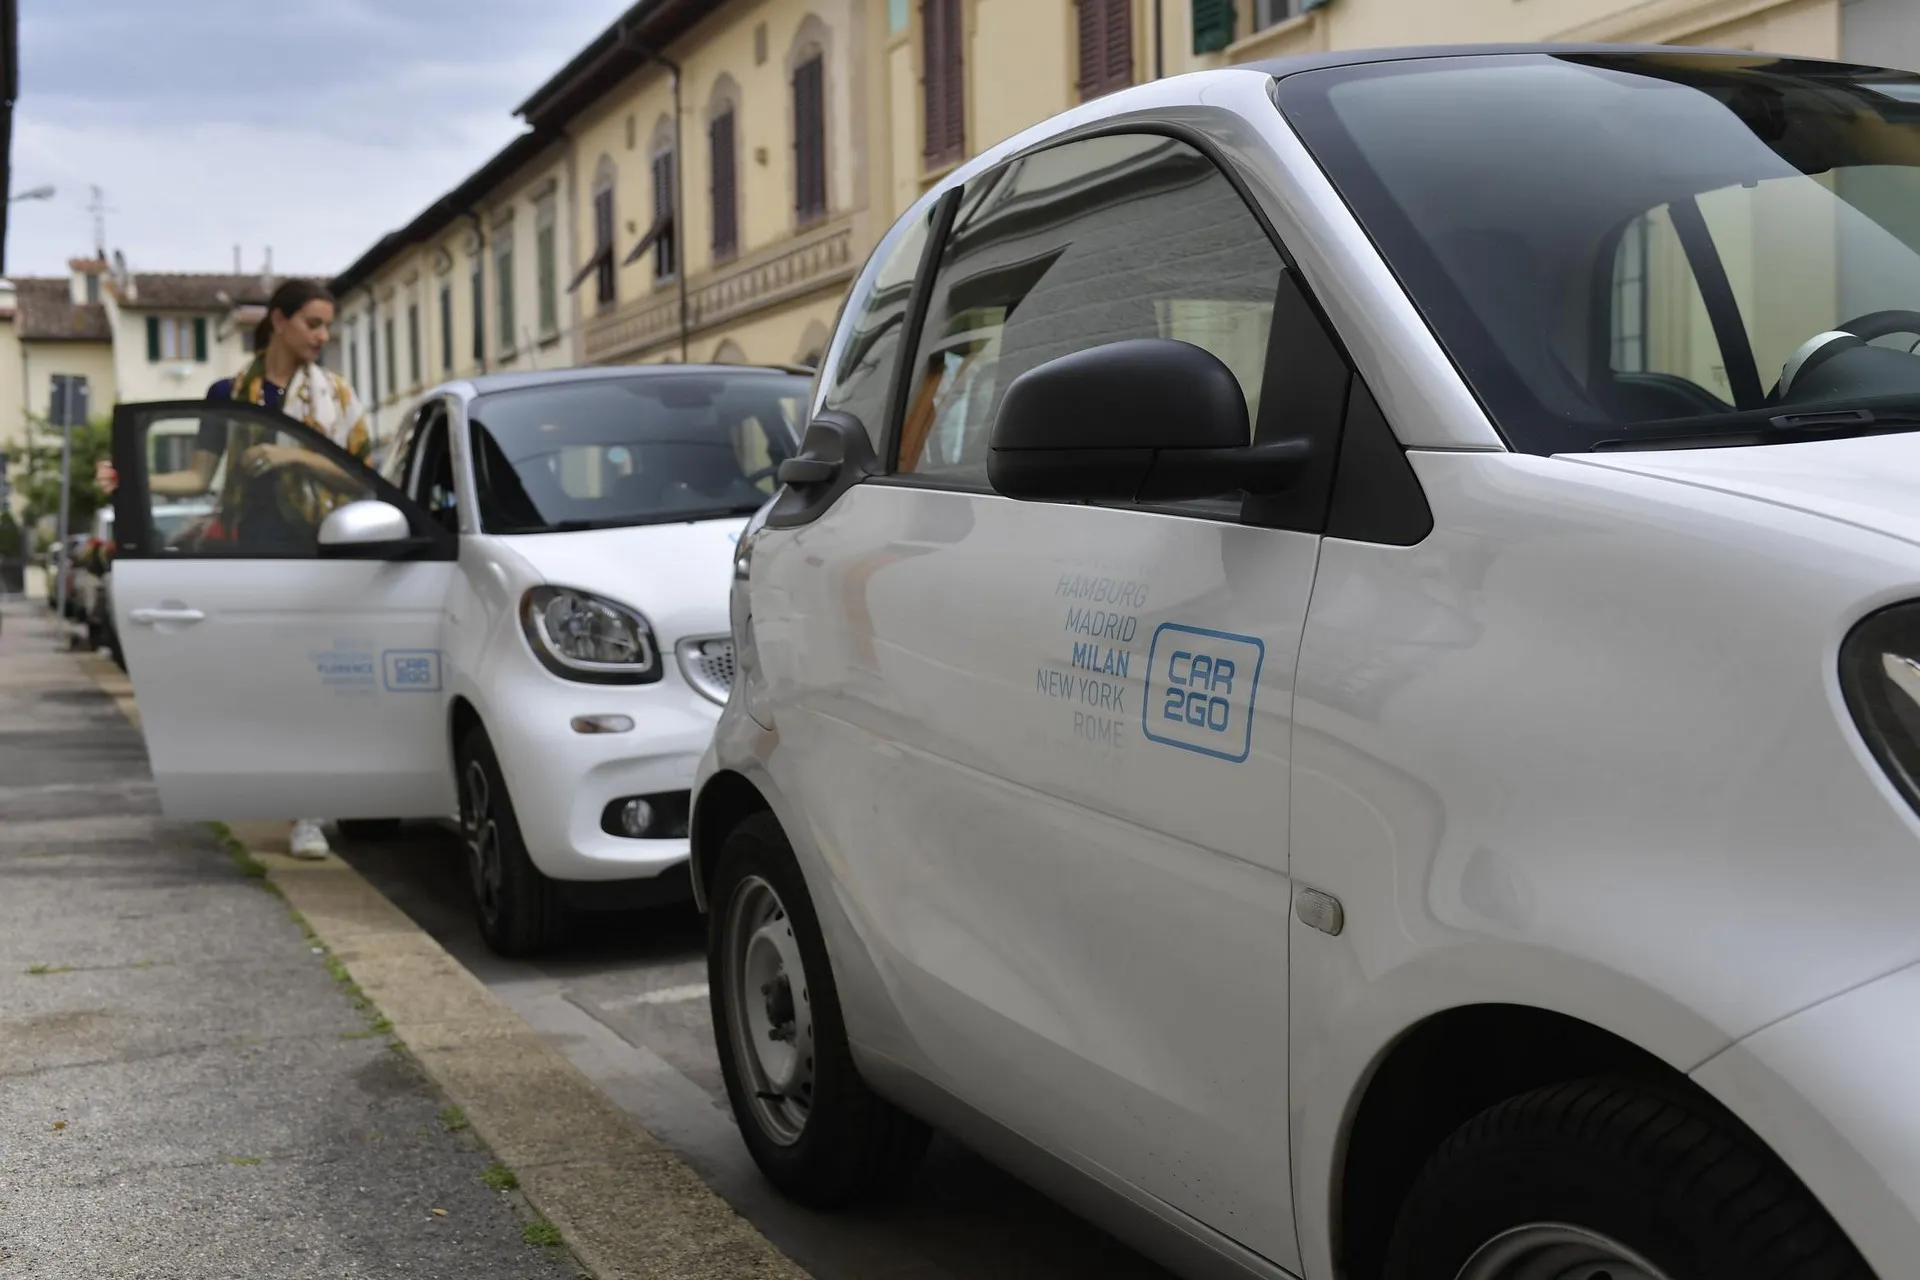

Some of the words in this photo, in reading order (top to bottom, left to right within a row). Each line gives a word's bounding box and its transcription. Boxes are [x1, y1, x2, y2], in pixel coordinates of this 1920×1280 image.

[1055, 573, 1149, 608] HAMBURG
[1065, 606, 1137, 642] MADRID
[1072, 641, 1131, 678] MILAN
[1168, 650, 1235, 695] CAR
[1036, 668, 1074, 700] NEW
[1079, 677, 1125, 714] YORK
[1163, 687, 1230, 732] 2GO
[1073, 711, 1124, 749] ROME
